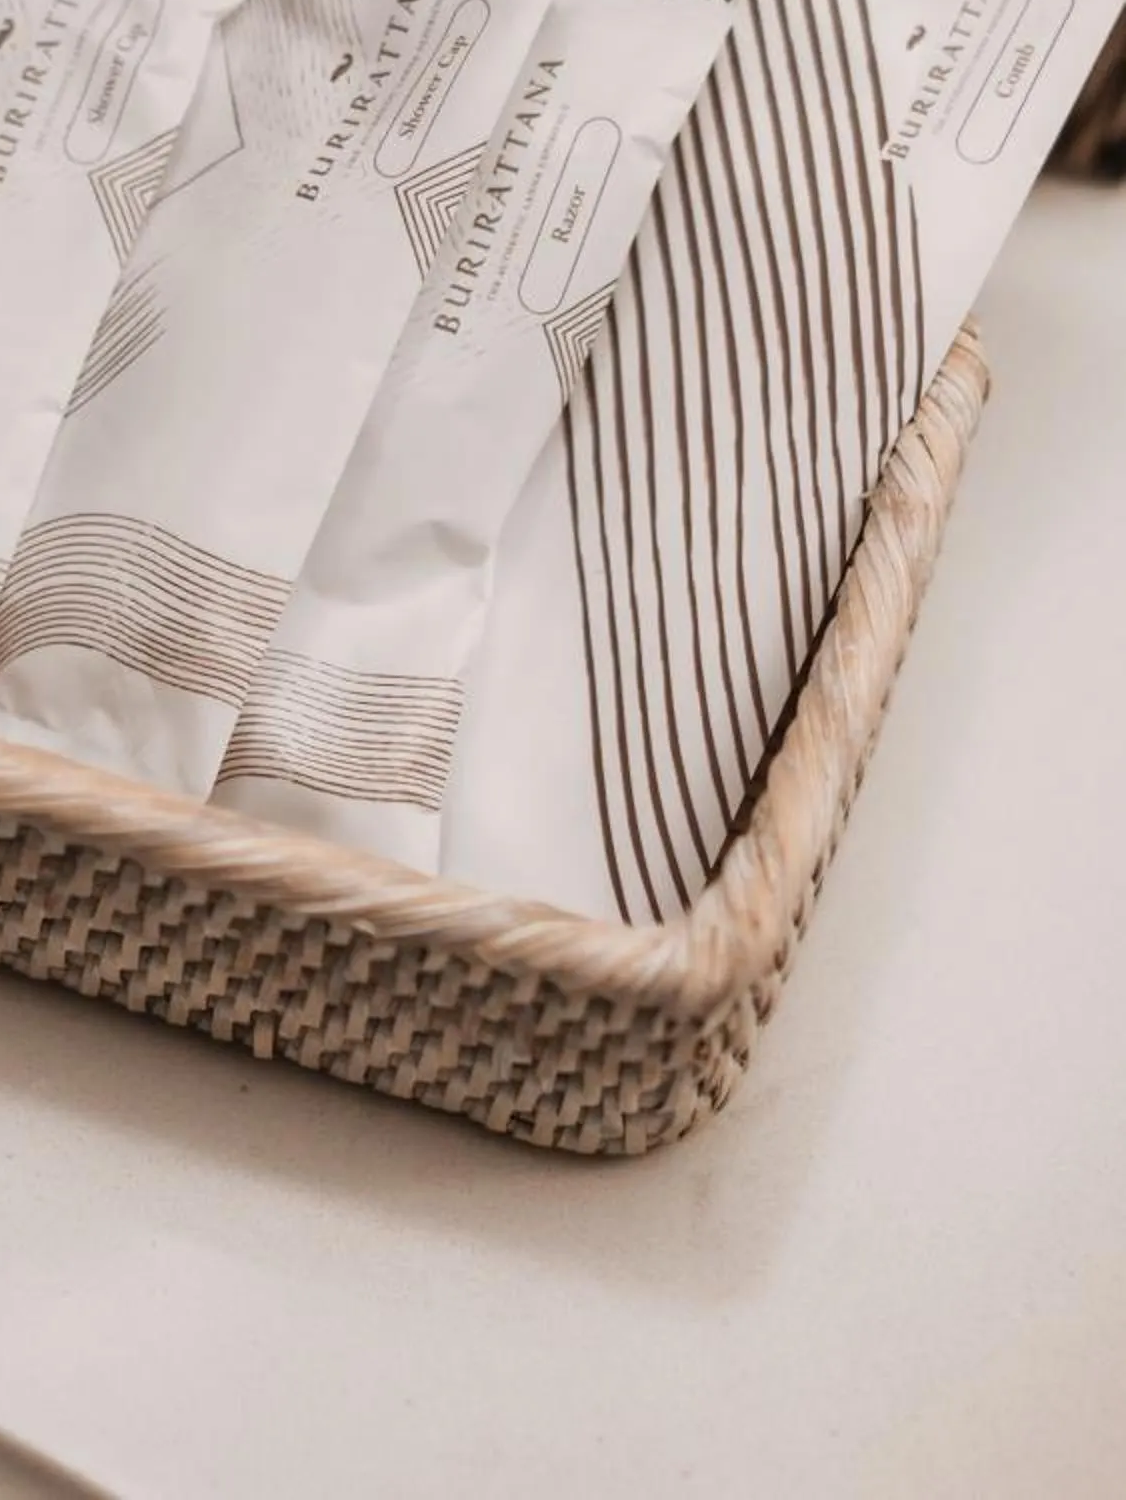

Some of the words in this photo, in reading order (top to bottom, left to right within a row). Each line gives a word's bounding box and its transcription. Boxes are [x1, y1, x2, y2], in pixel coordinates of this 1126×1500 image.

[86, 56, 126, 129] Shower
[115, 22, 149, 53] Cap
[397, 74, 443, 141] Shower
[437, 34, 471, 70] Cap
[993, 42, 1037, 100] Comb
[433, 58, 565, 336] BURIRATTANA
[550, 183, 587, 245] Razor
